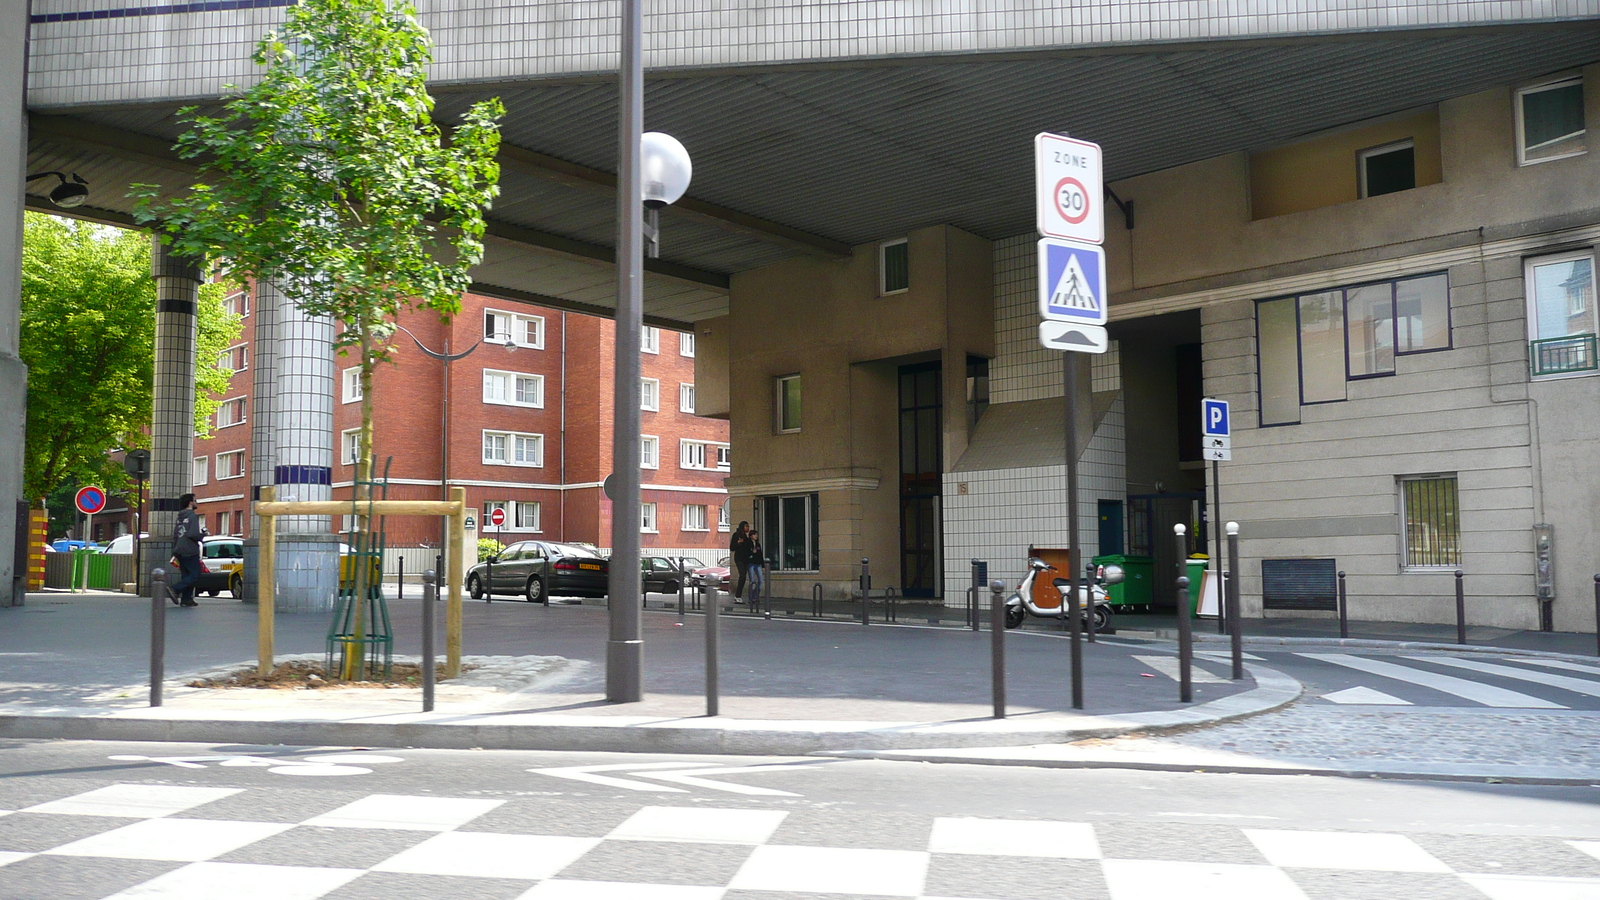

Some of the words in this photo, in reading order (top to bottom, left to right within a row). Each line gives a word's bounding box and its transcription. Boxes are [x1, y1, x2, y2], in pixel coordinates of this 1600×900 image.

[1054, 151, 1087, 169] ZONE
[1061, 189, 1083, 211] 30
[1210, 406, 1222, 429] P
